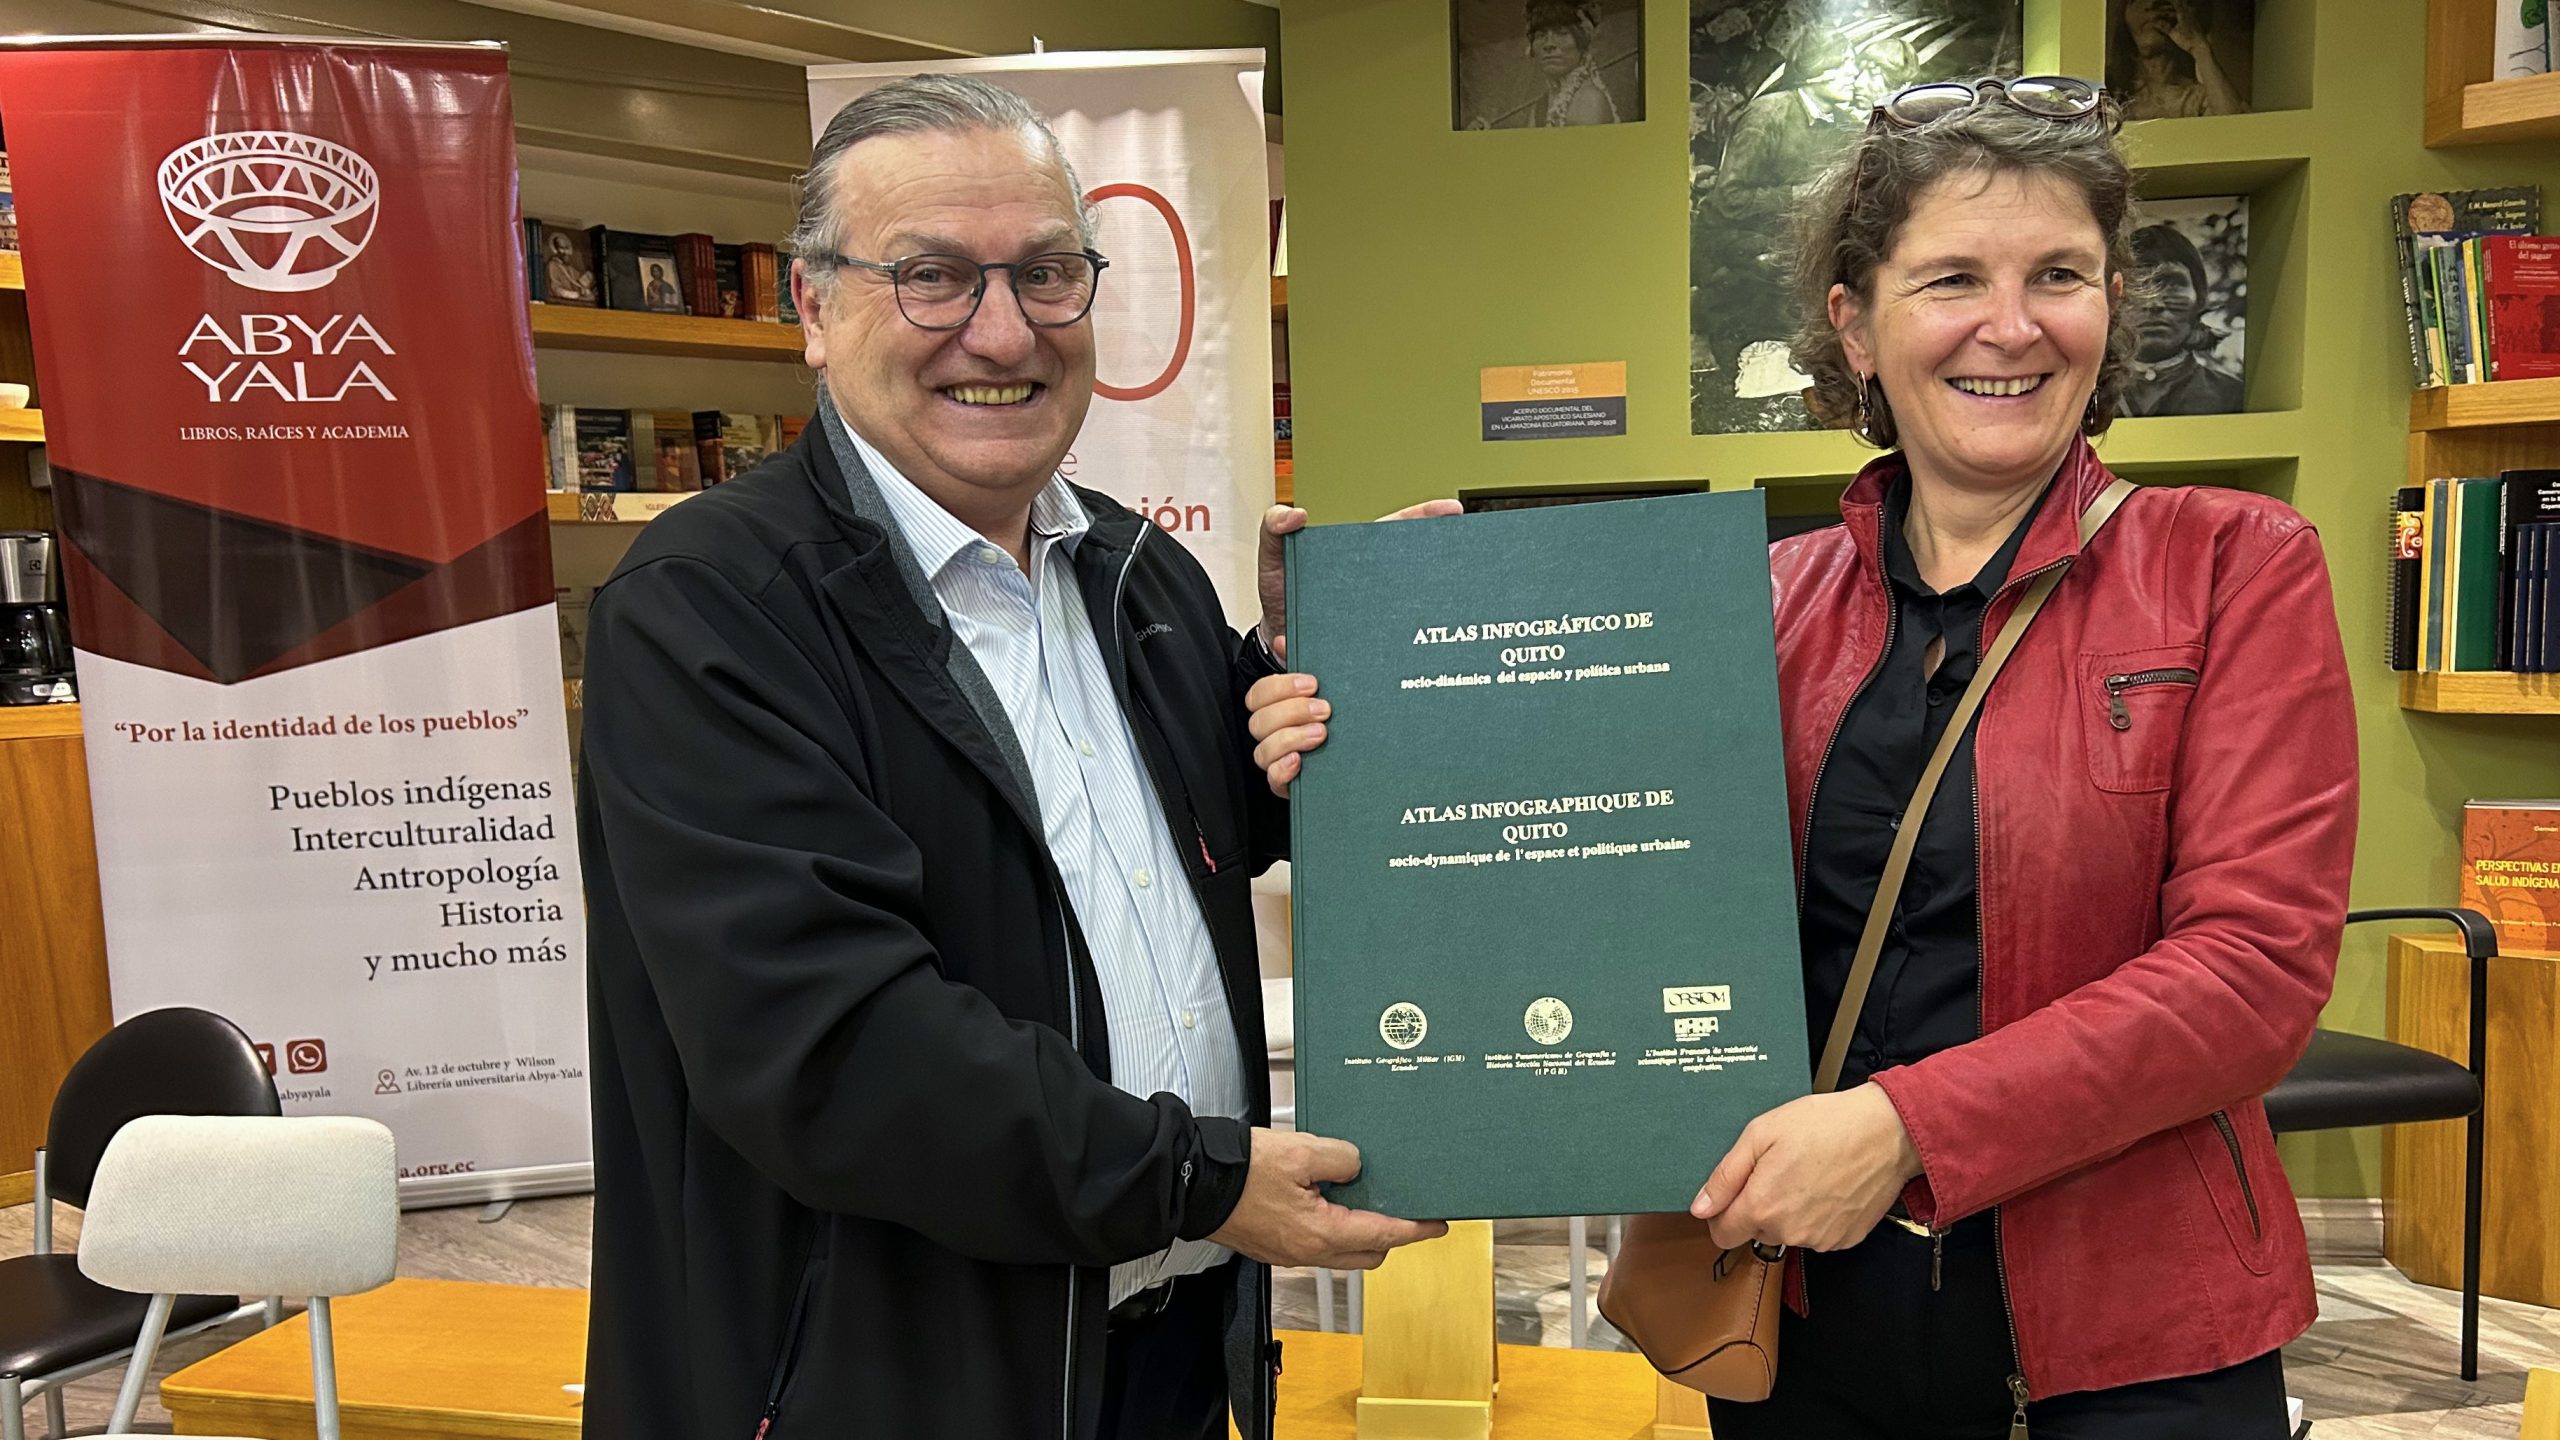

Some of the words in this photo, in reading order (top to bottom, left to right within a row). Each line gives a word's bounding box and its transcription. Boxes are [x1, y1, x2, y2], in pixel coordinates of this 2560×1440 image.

[178, 314, 396, 356] ABYA
[180, 361, 398, 402] YALA
[1527, 386, 1560, 395] UNESCO
[1539, 405, 1581, 414] DOCUMENTAL
[180, 427, 242, 441] LIBROS,
[246, 425, 304, 440] RAÍCES
[306, 426, 317, 439] Y
[321, 425, 410, 439] ACADEMIA
[1413, 624, 1478, 645] ATLAS
[1482, 614, 1621, 640] INFOGRÁFICO
[1624, 611, 1654, 630] DE
[1500, 644, 1566, 667] QUITO
[1401, 673, 1491, 690] socio-dinámica
[1497, 668, 1516, 684] del
[1518, 667, 1562, 685] espacio
[1565, 669, 1573, 682] y
[1576, 664, 1621, 681] política
[1624, 661, 1670, 675] urbana
[183, 720, 206, 742] la
[213, 715, 337, 741] identidad
[344, 713, 373, 736] de
[380, 712, 416, 735] los
[423, 708, 530, 738] pueblos”
[269, 780, 395, 811] Pueblos
[404, 775, 552, 809] indígenas
[1400, 804, 1467, 825] ATLAS
[1471, 792, 1641, 821] INFOGRAPHIQUE
[1645, 789, 1674, 807] DE
[291, 814, 556, 853] Interculturalidad
[1502, 822, 1568, 845] QUITO
[1389, 851, 1493, 868] socio-dynamique
[1495, 850, 1510, 862] de
[1567, 845, 1580, 858] et
[1582, 840, 1638, 859] politique
[1641, 837, 1691, 853] urbaine
[2475, 860, 2549, 873] PERSPECTIVAS
[354, 857, 559, 894] Antropología
[2475, 874, 2510, 887] SALUD
[440, 900, 563, 928] Historia
[364, 953, 382, 981] y
[391, 941, 498, 973] mucho
[507, 937, 567, 964] más
[405, 1067, 423, 1078] Av.
[425, 1065, 438, 1076] 12
[441, 1063, 455, 1074] de
[457, 1060, 501, 1073] octubre
[504, 1061, 511, 1071] y
[516, 1057, 556, 1068] Wilson
[407, 1079, 452, 1092] Librería
[455, 1071, 526, 1088] universitaria
[528, 1068, 583, 1084] Abya-Yala
